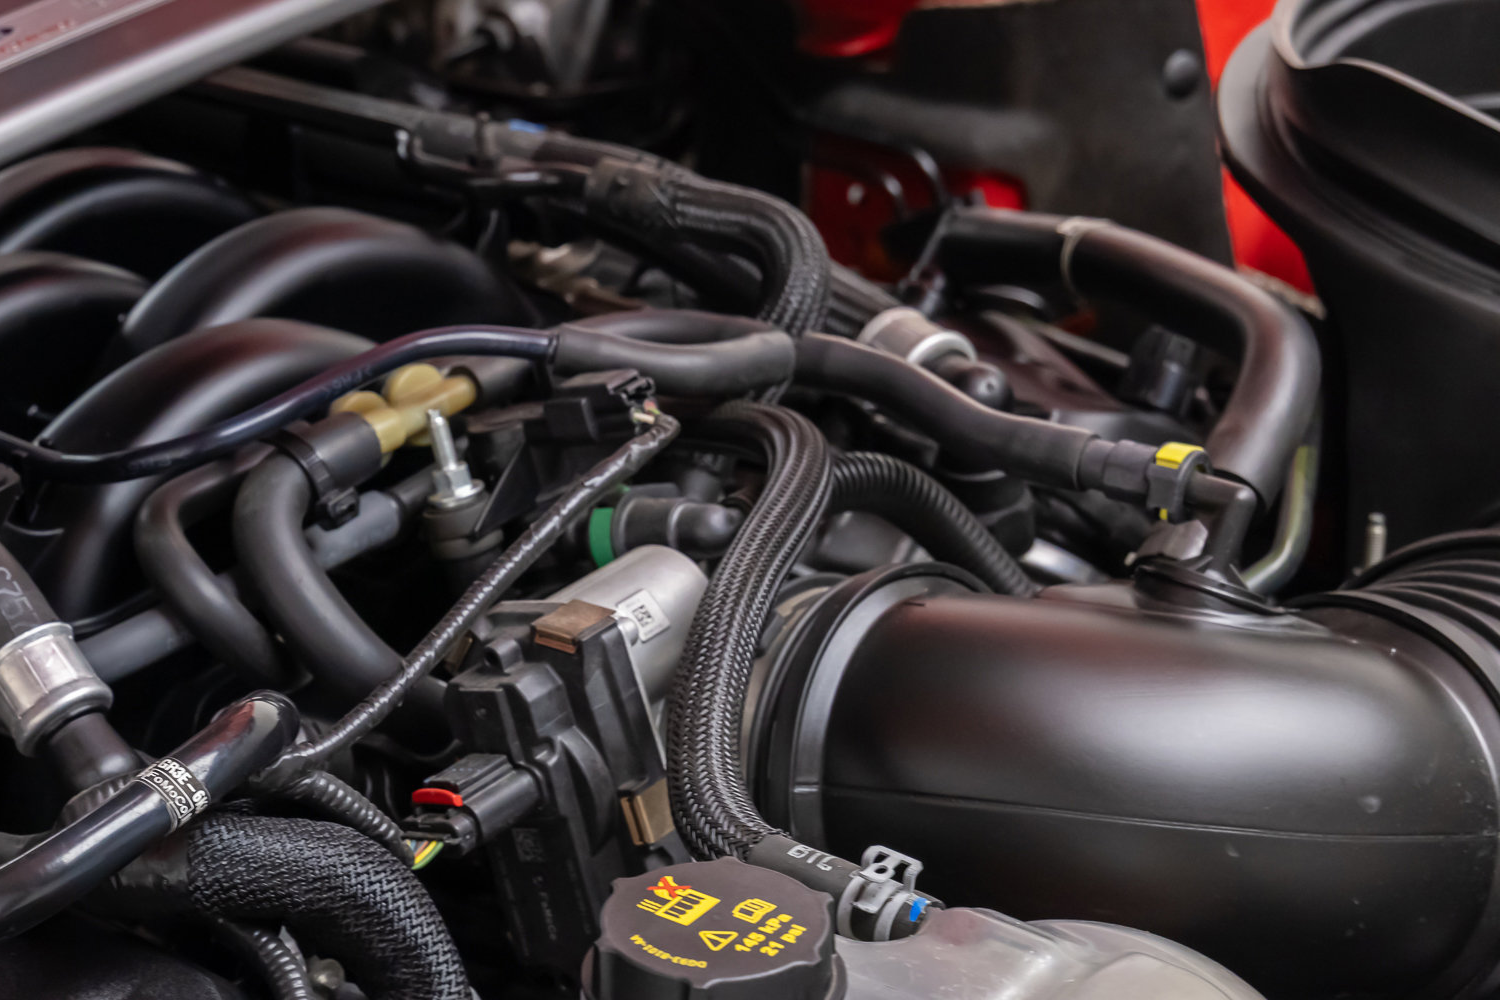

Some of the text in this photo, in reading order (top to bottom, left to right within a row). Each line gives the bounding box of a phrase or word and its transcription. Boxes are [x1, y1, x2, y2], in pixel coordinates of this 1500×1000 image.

[145, 770, 189, 814] FoMoCo
[734, 913, 793, 953] 145 kPa
[759, 923, 807, 957] 21 psi
